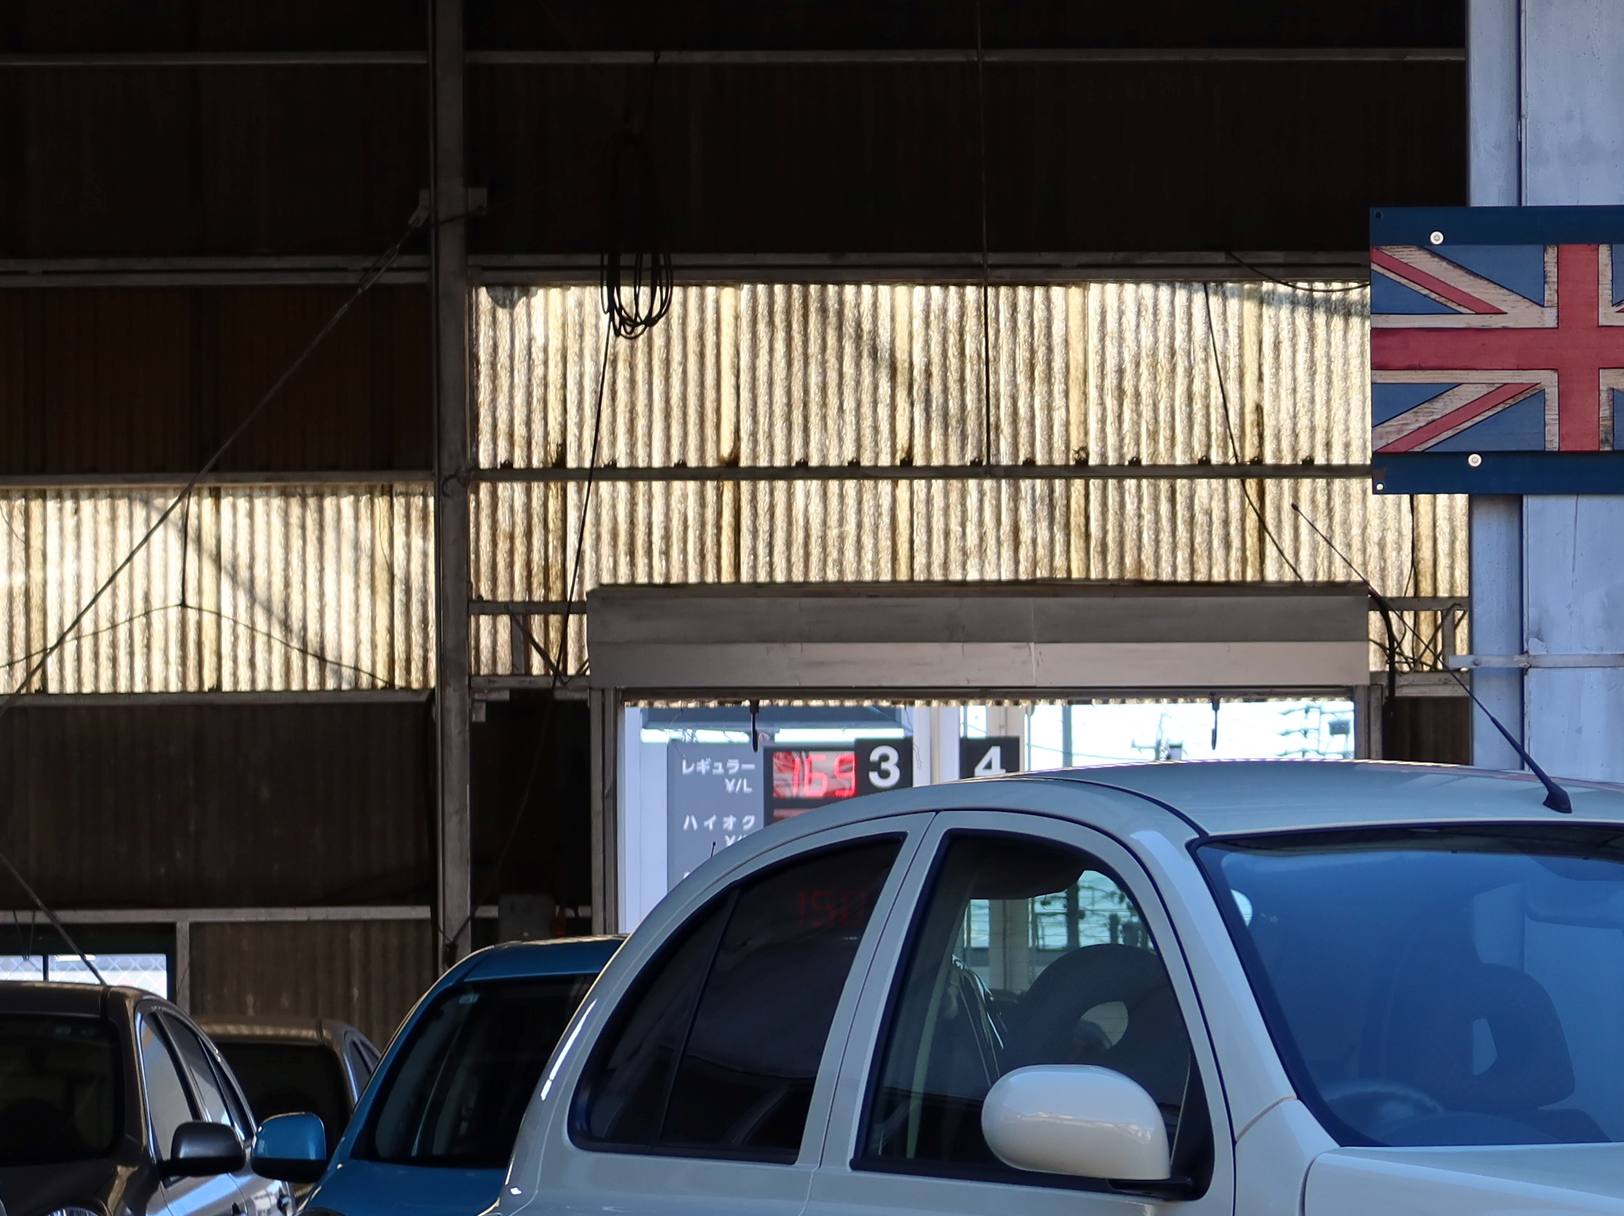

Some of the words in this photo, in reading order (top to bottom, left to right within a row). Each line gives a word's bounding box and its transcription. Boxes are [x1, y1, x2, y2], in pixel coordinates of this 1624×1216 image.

[682, 758, 756, 775] レギュラー
[868, 745, 901, 789] 3
[974, 745, 1007, 777] 4
[683, 814, 756, 831] ハイオク
